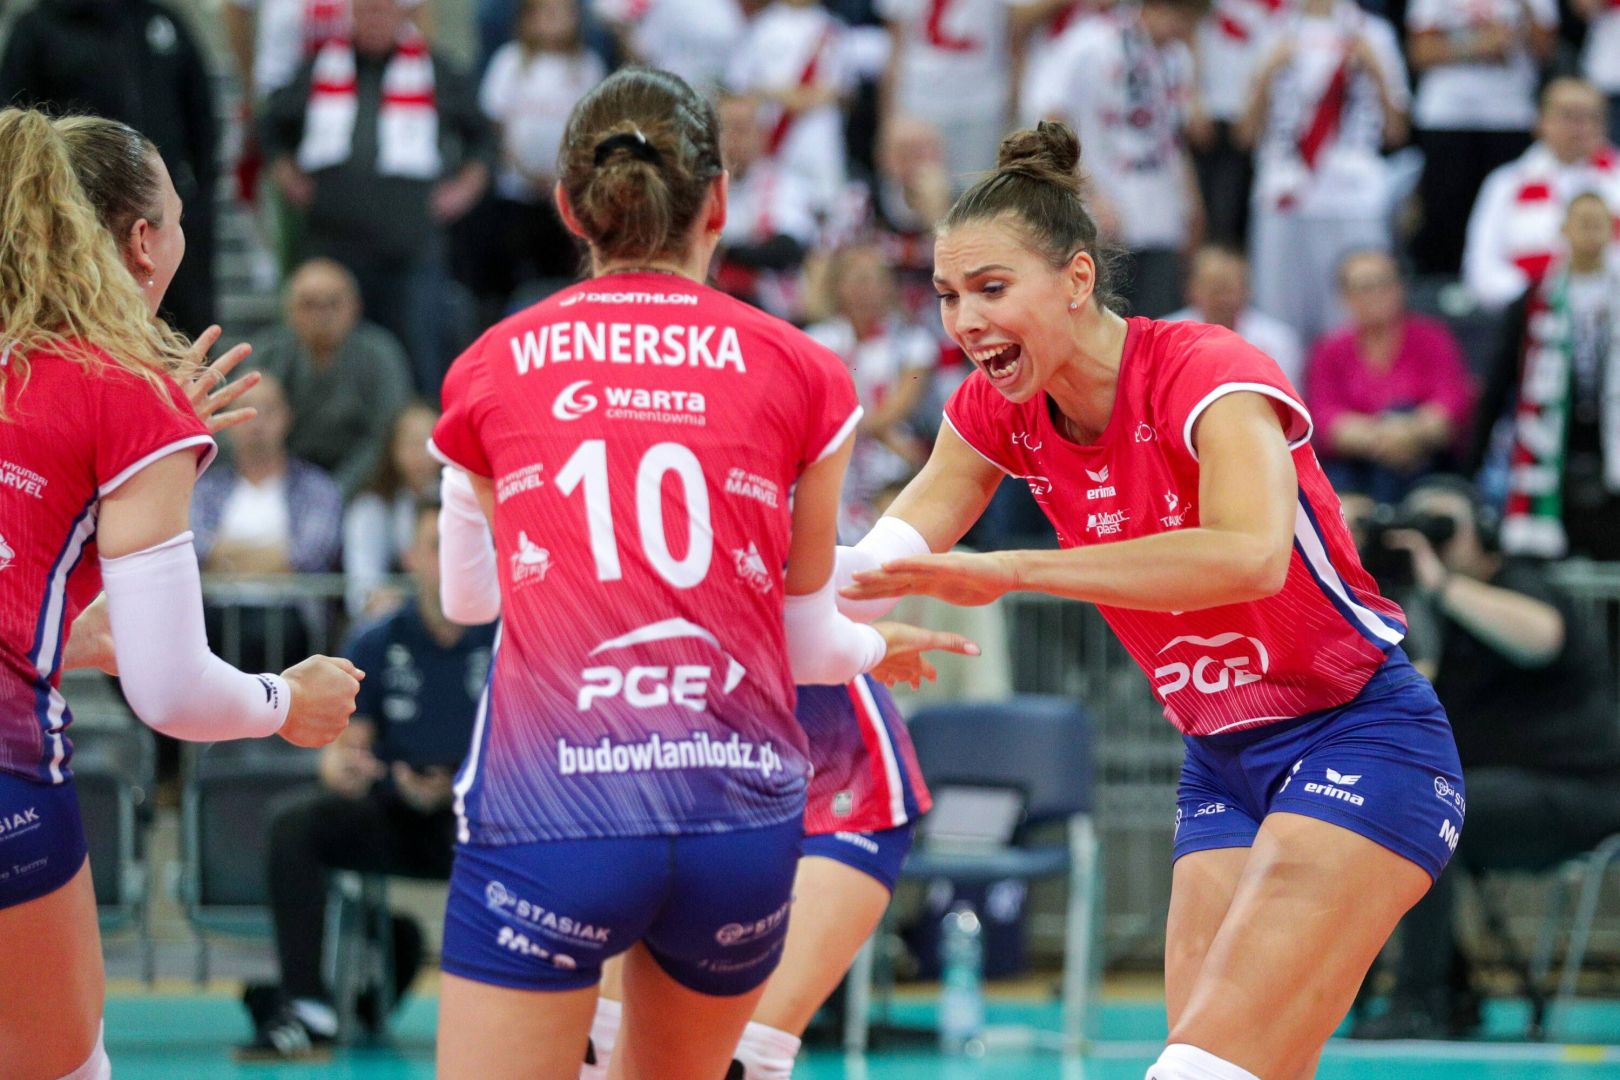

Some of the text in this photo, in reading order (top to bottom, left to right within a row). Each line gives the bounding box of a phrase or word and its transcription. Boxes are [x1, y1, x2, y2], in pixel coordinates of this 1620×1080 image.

[586, 292, 698, 305] DECATHLON
[510, 321, 747, 375] WENERSKA
[604, 408, 706, 426] cementownia
[554, 439, 714, 588] 10
[726, 478, 778, 509] MARVEL
[577, 665, 711, 712] PGE
[1155, 655, 1262, 702] PGE
[1304, 782, 1365, 807] erima
[516, 899, 611, 942] STASIAK
